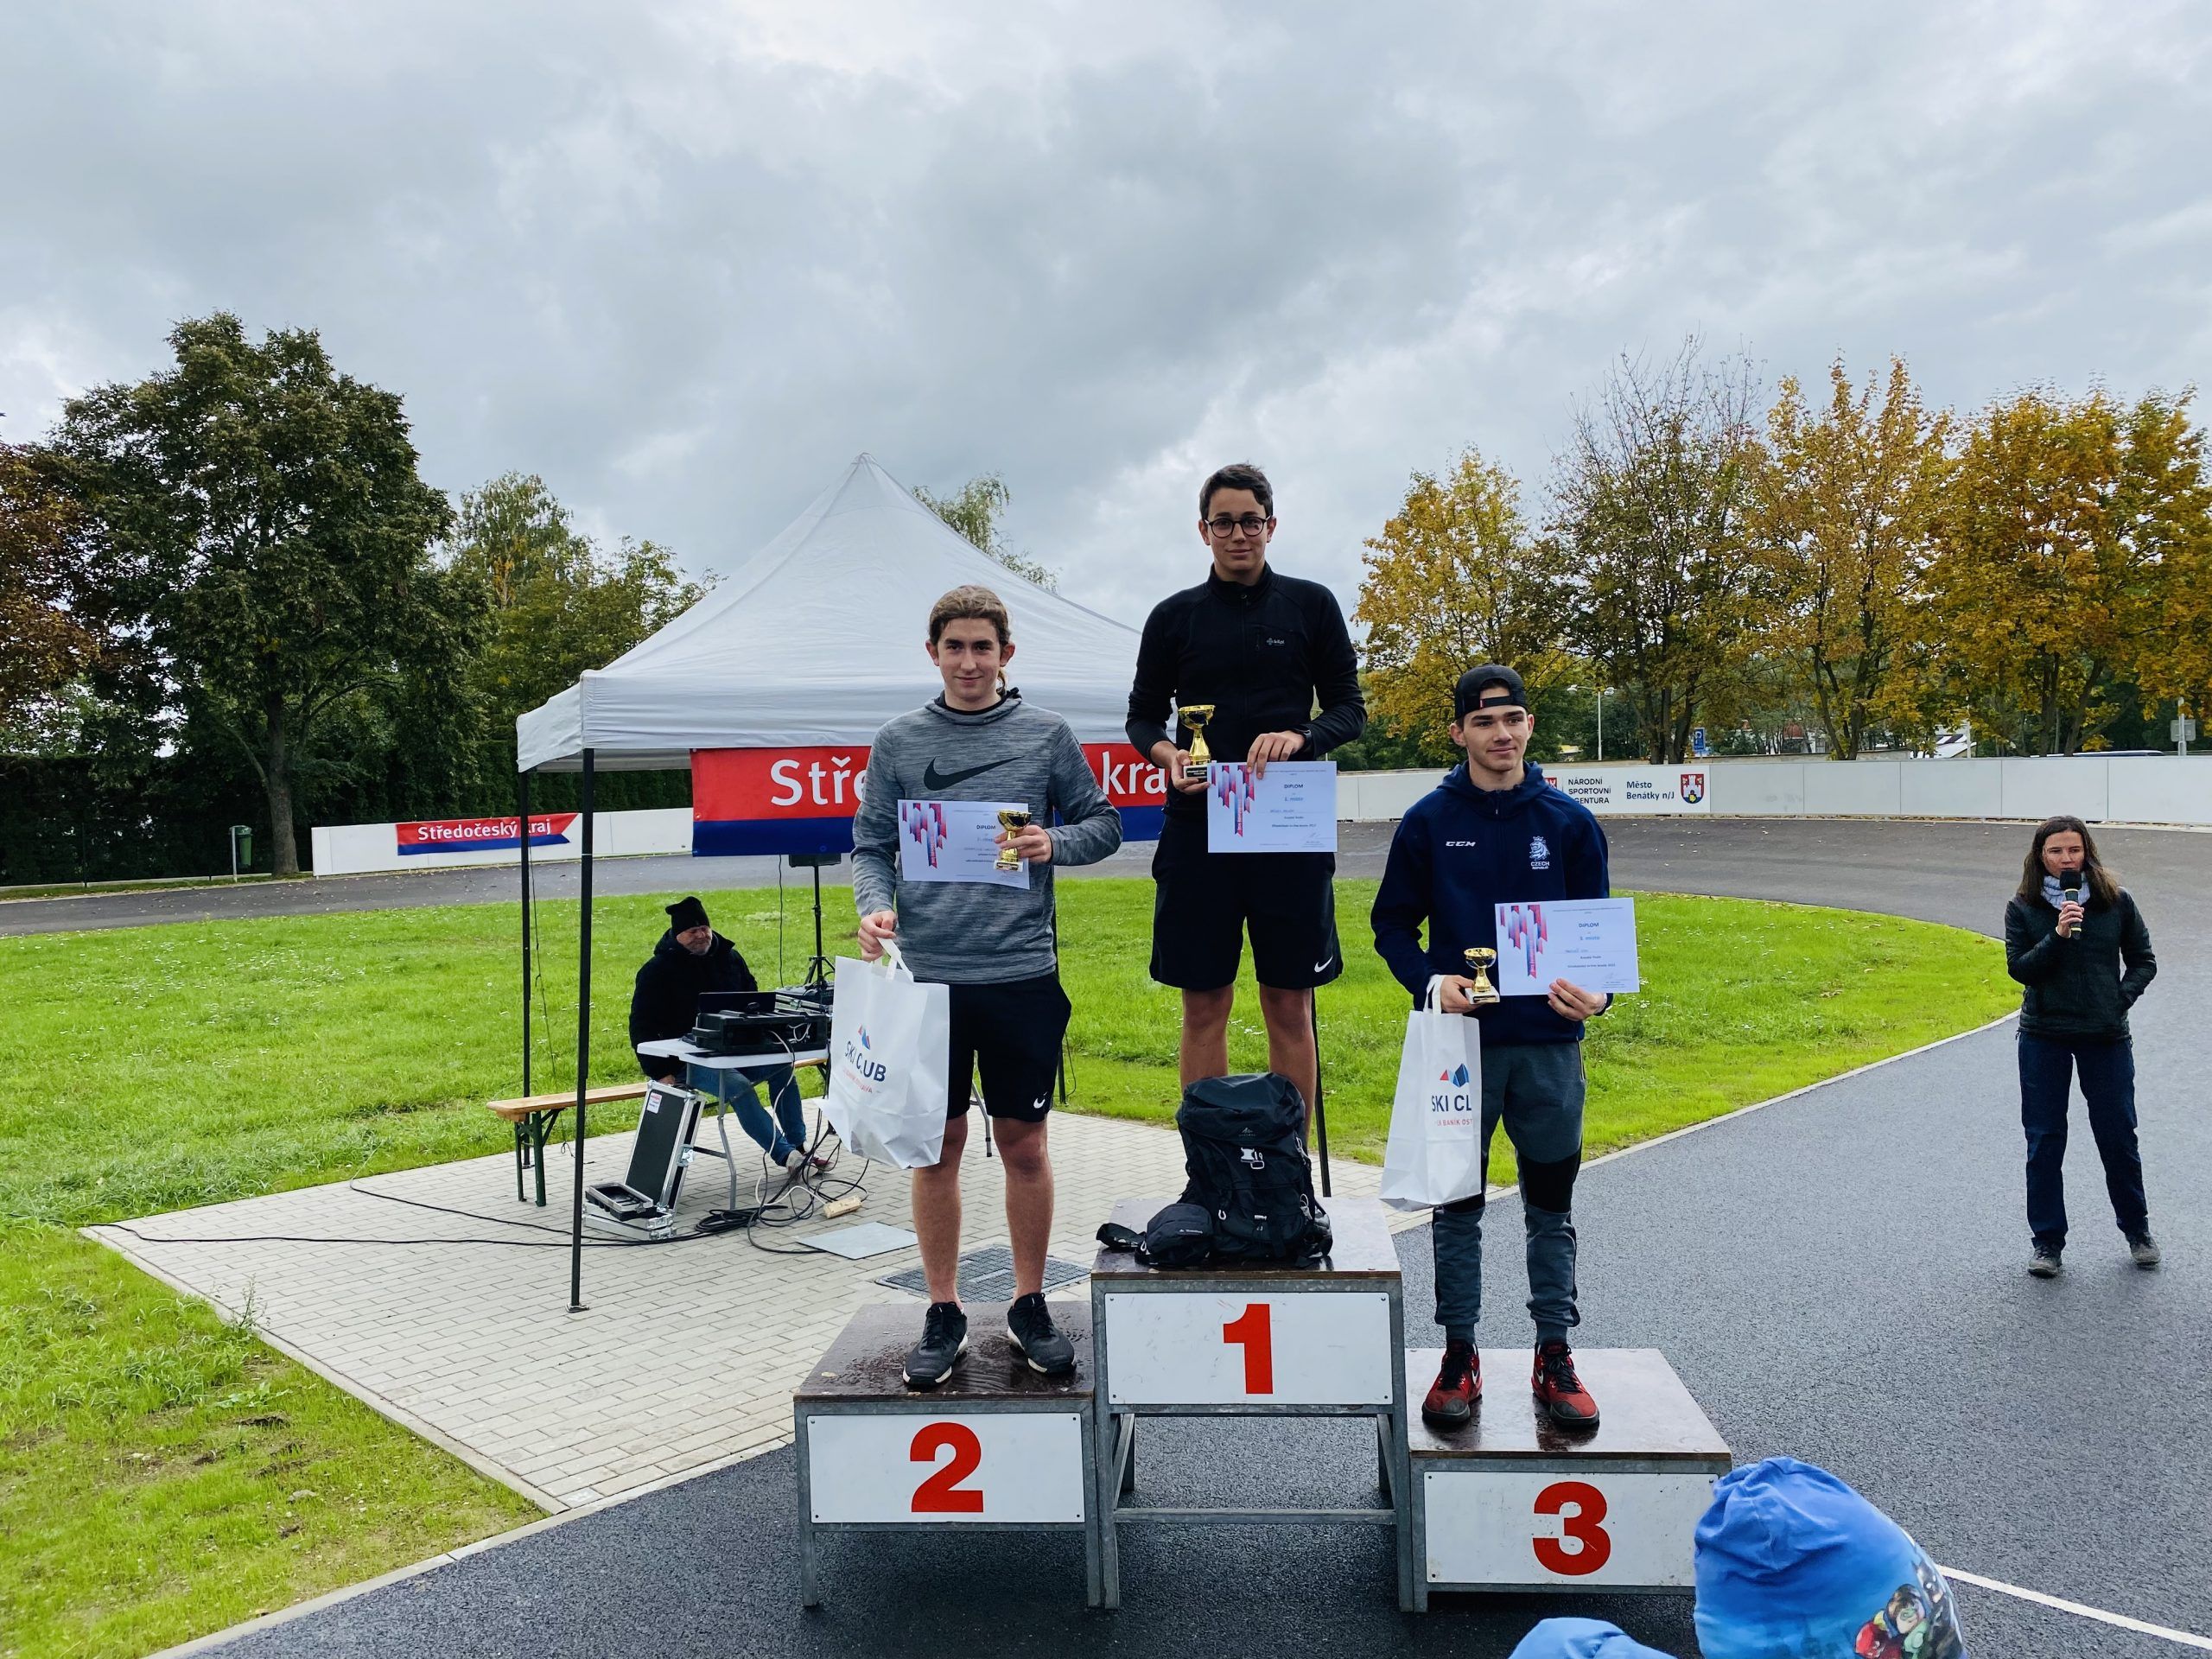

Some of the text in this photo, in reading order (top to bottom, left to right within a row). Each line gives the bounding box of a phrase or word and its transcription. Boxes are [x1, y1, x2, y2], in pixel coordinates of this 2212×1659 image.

[1567, 777, 1603, 785] NÁRODNÍ
[1568, 785, 1611, 795] SPORTOVNÍ
[1626, 791, 1675, 800] Benátky n/J
[417, 818, 551, 841] Středočeský raj
[856, 1052, 887, 1082] CUB
[1431, 1095, 1449, 1112] SKI
[1224, 1303, 1272, 1394] 1
[910, 1422, 983, 1512] 2
[1533, 1481, 1611, 1575] 3
